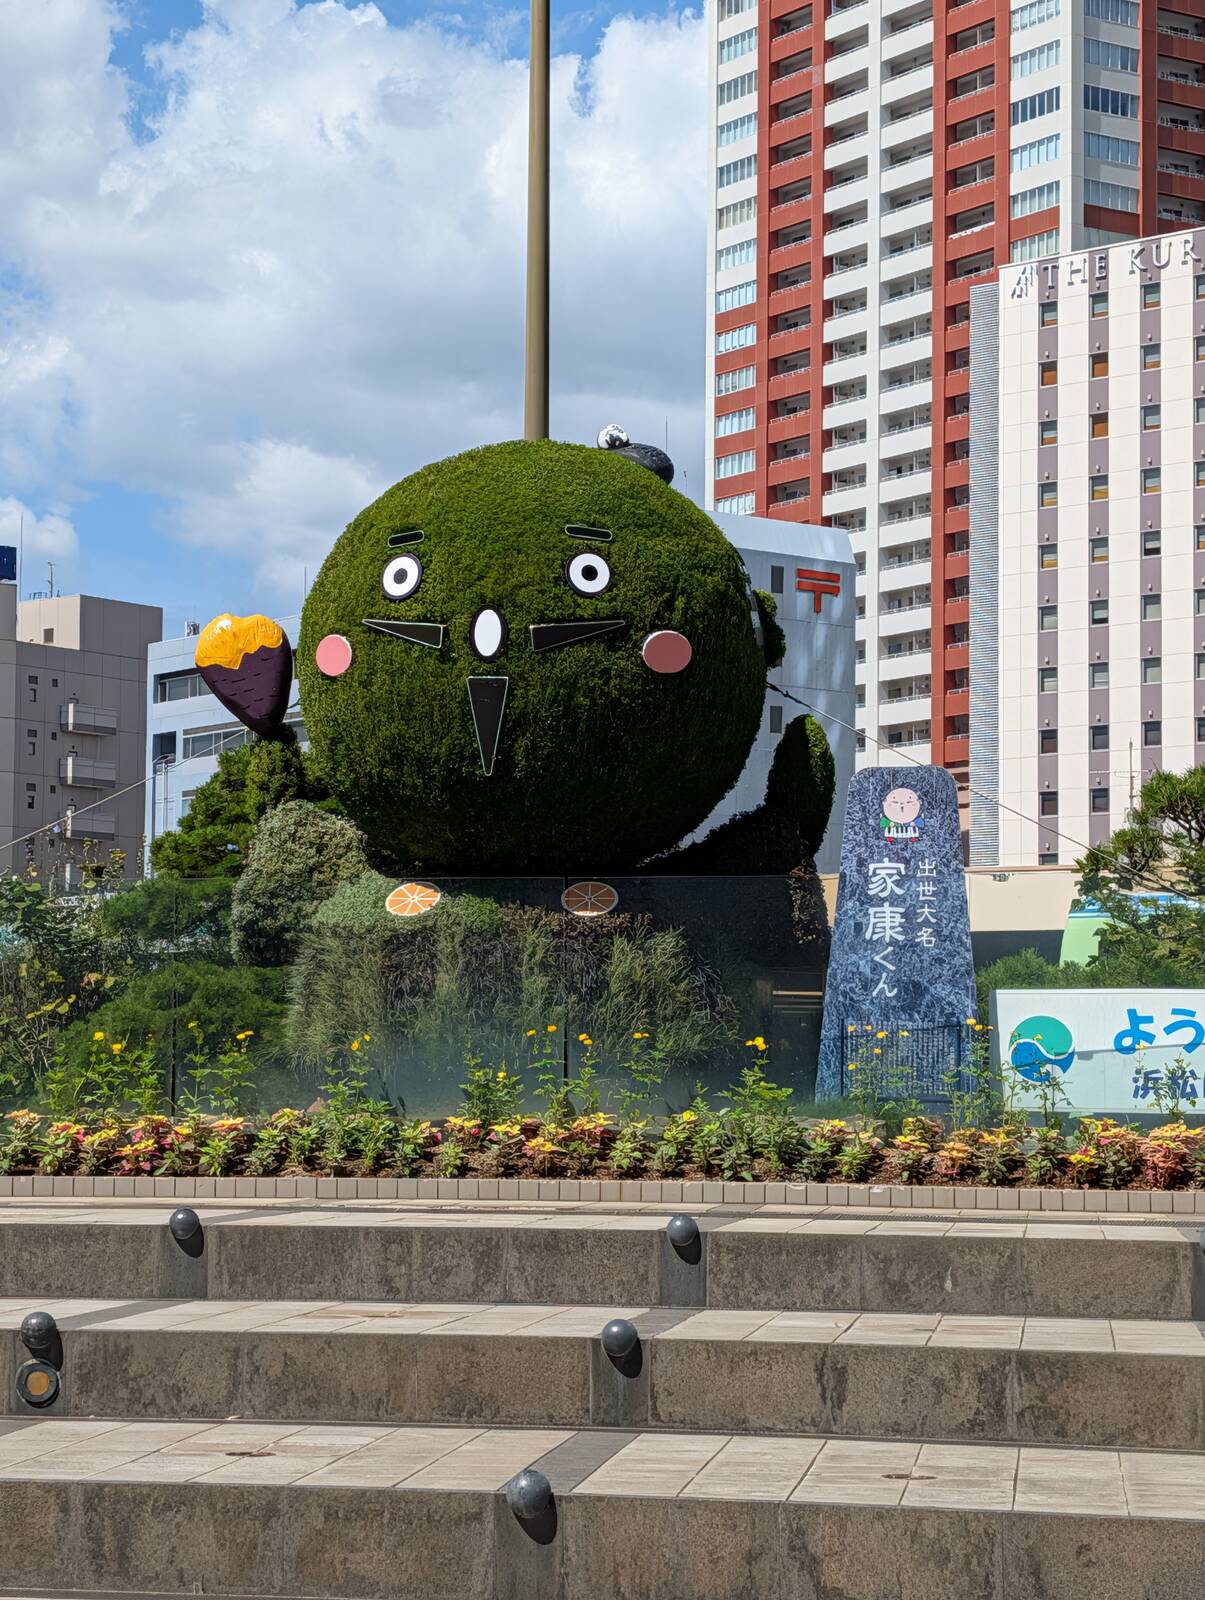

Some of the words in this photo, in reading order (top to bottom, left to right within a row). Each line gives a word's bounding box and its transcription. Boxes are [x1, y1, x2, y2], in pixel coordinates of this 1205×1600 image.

[1042, 253, 1107, 290] THE
[1128, 239, 1201, 275] KUR
[865, 857, 906, 998] 家康くん
[915, 858, 938, 947] 出世大名
[1114, 1008, 1205, 1055] よう
[1132, 1069, 1205, 1099] 浜松
